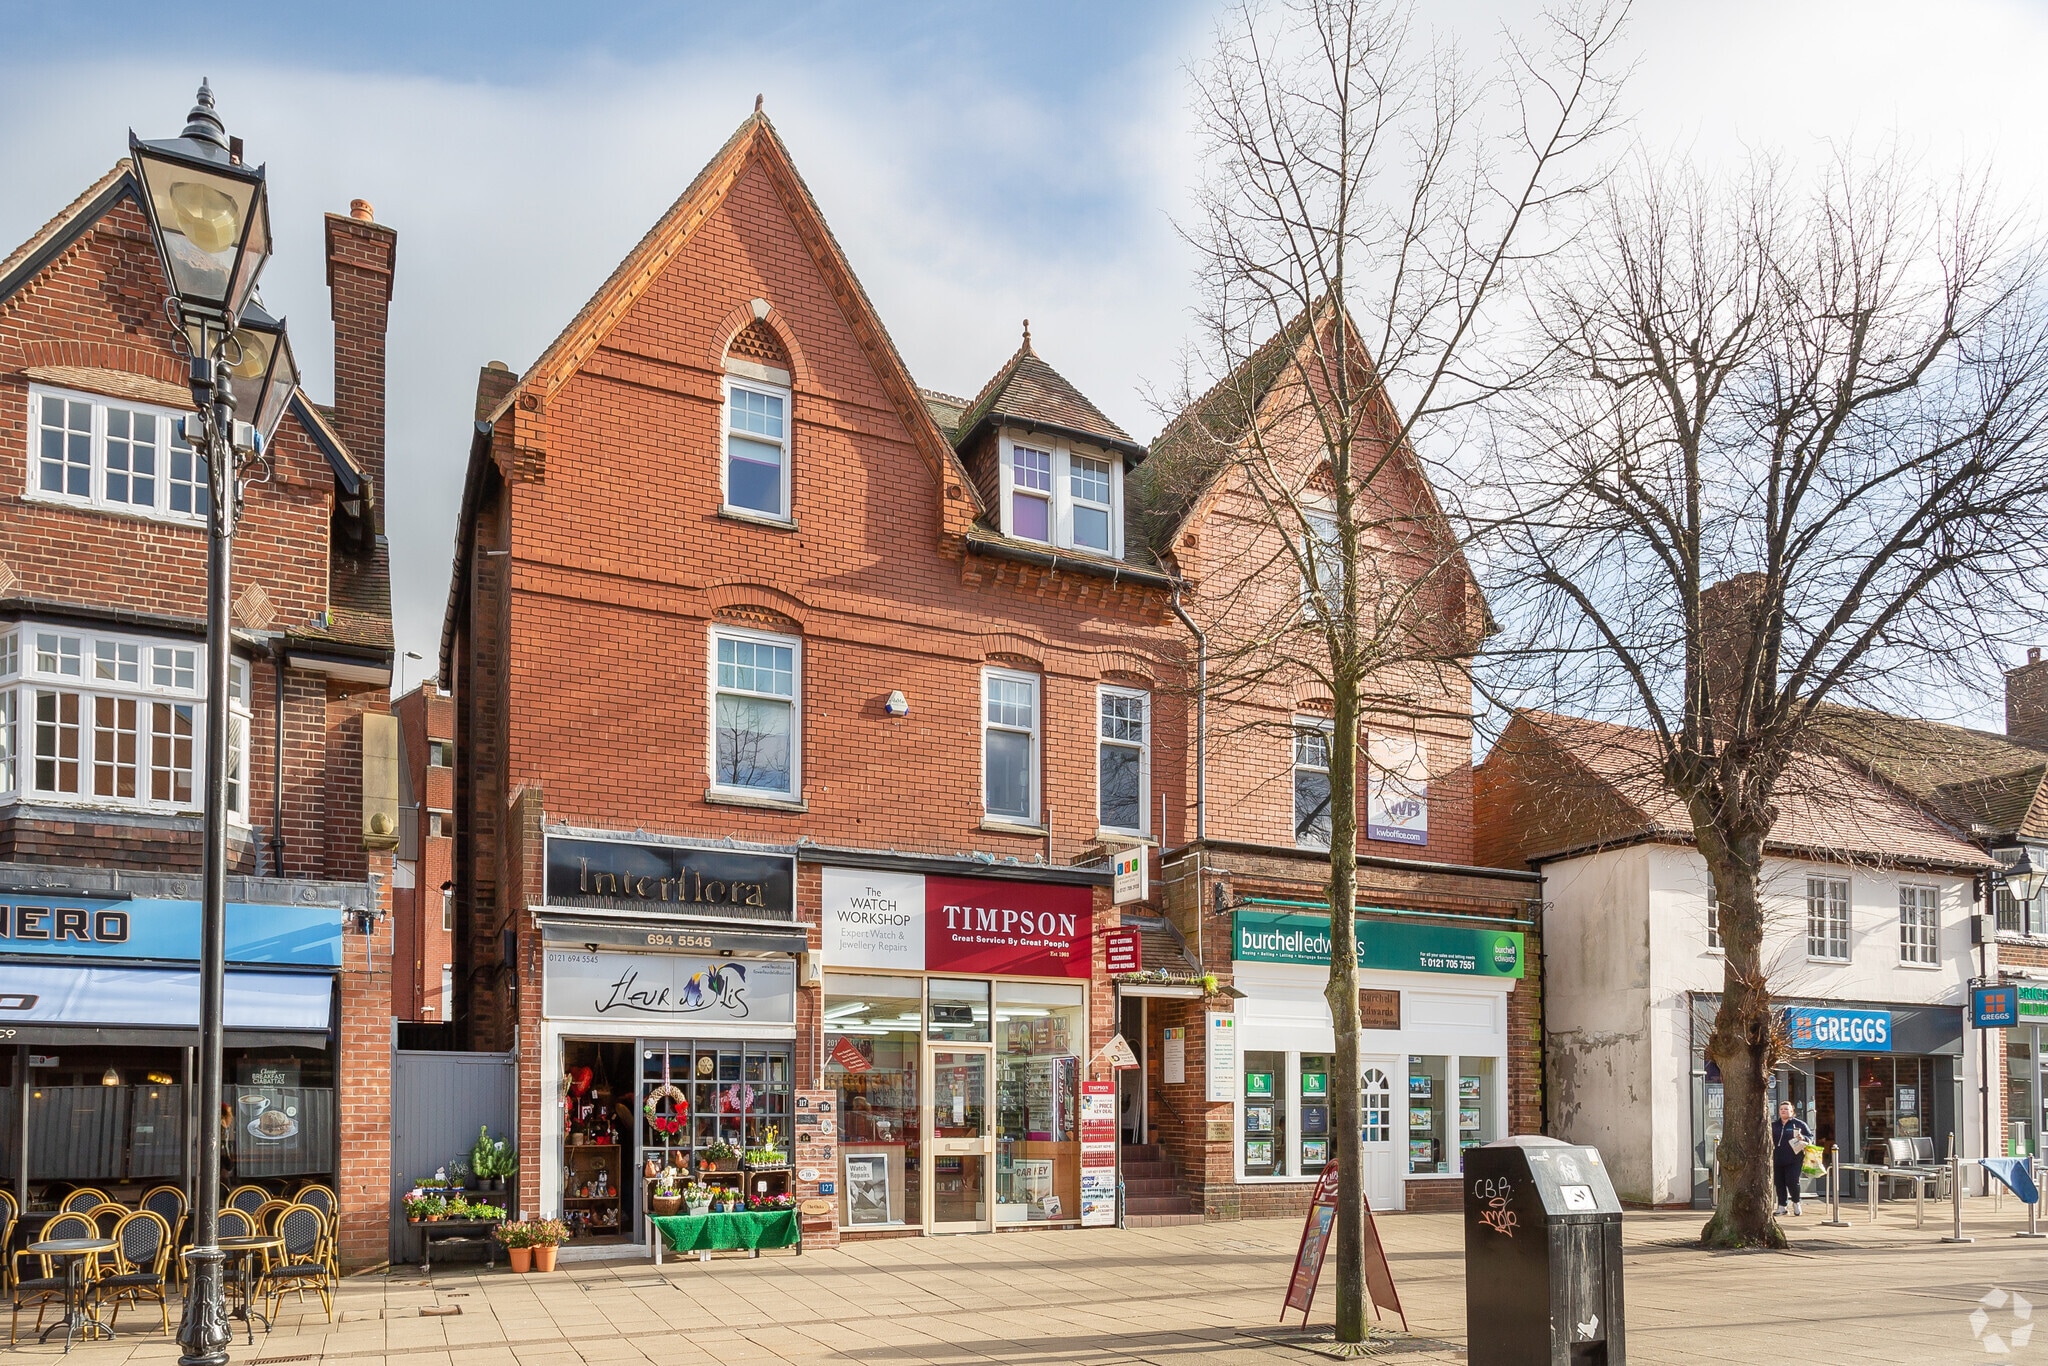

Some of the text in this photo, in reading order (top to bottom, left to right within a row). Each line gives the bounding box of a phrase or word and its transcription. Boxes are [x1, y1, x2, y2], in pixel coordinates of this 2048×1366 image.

[1376, 828, 1421, 841] kwboffice.com
[865, 887, 882, 897] The
[850, 897, 897, 911] WATCH
[837, 910, 911, 926] WORKSHOP
[942, 905, 1077, 937] TIMPSON
[841, 928, 905, 940] Expert Watch &
[647, 934, 712, 948] 694 5545
[839, 939, 908, 953] Jewellery Repairs
[952, 933, 1070, 949] Great Service By Great People
[1494, 946, 1515, 954] burchell
[567, 955, 580, 963] 694
[581, 956, 599, 964] 5545
[1420, 958, 1475, 970] T: 0121 705 7551
[1494, 955, 1515, 963] edwards
[1361, 993, 1393, 1004] Burchell
[1360, 1005, 1393, 1016] Edwards
[1981, 1013, 2010, 1021] GREGGS
[1815, 1017, 1887, 1043] GREGGS
[798, 1099, 807, 1107] 117
[821, 1103, 830, 1111] 116
[1016, 1168, 1031, 1176] CAR
[821, 1184, 833, 1192] 127
